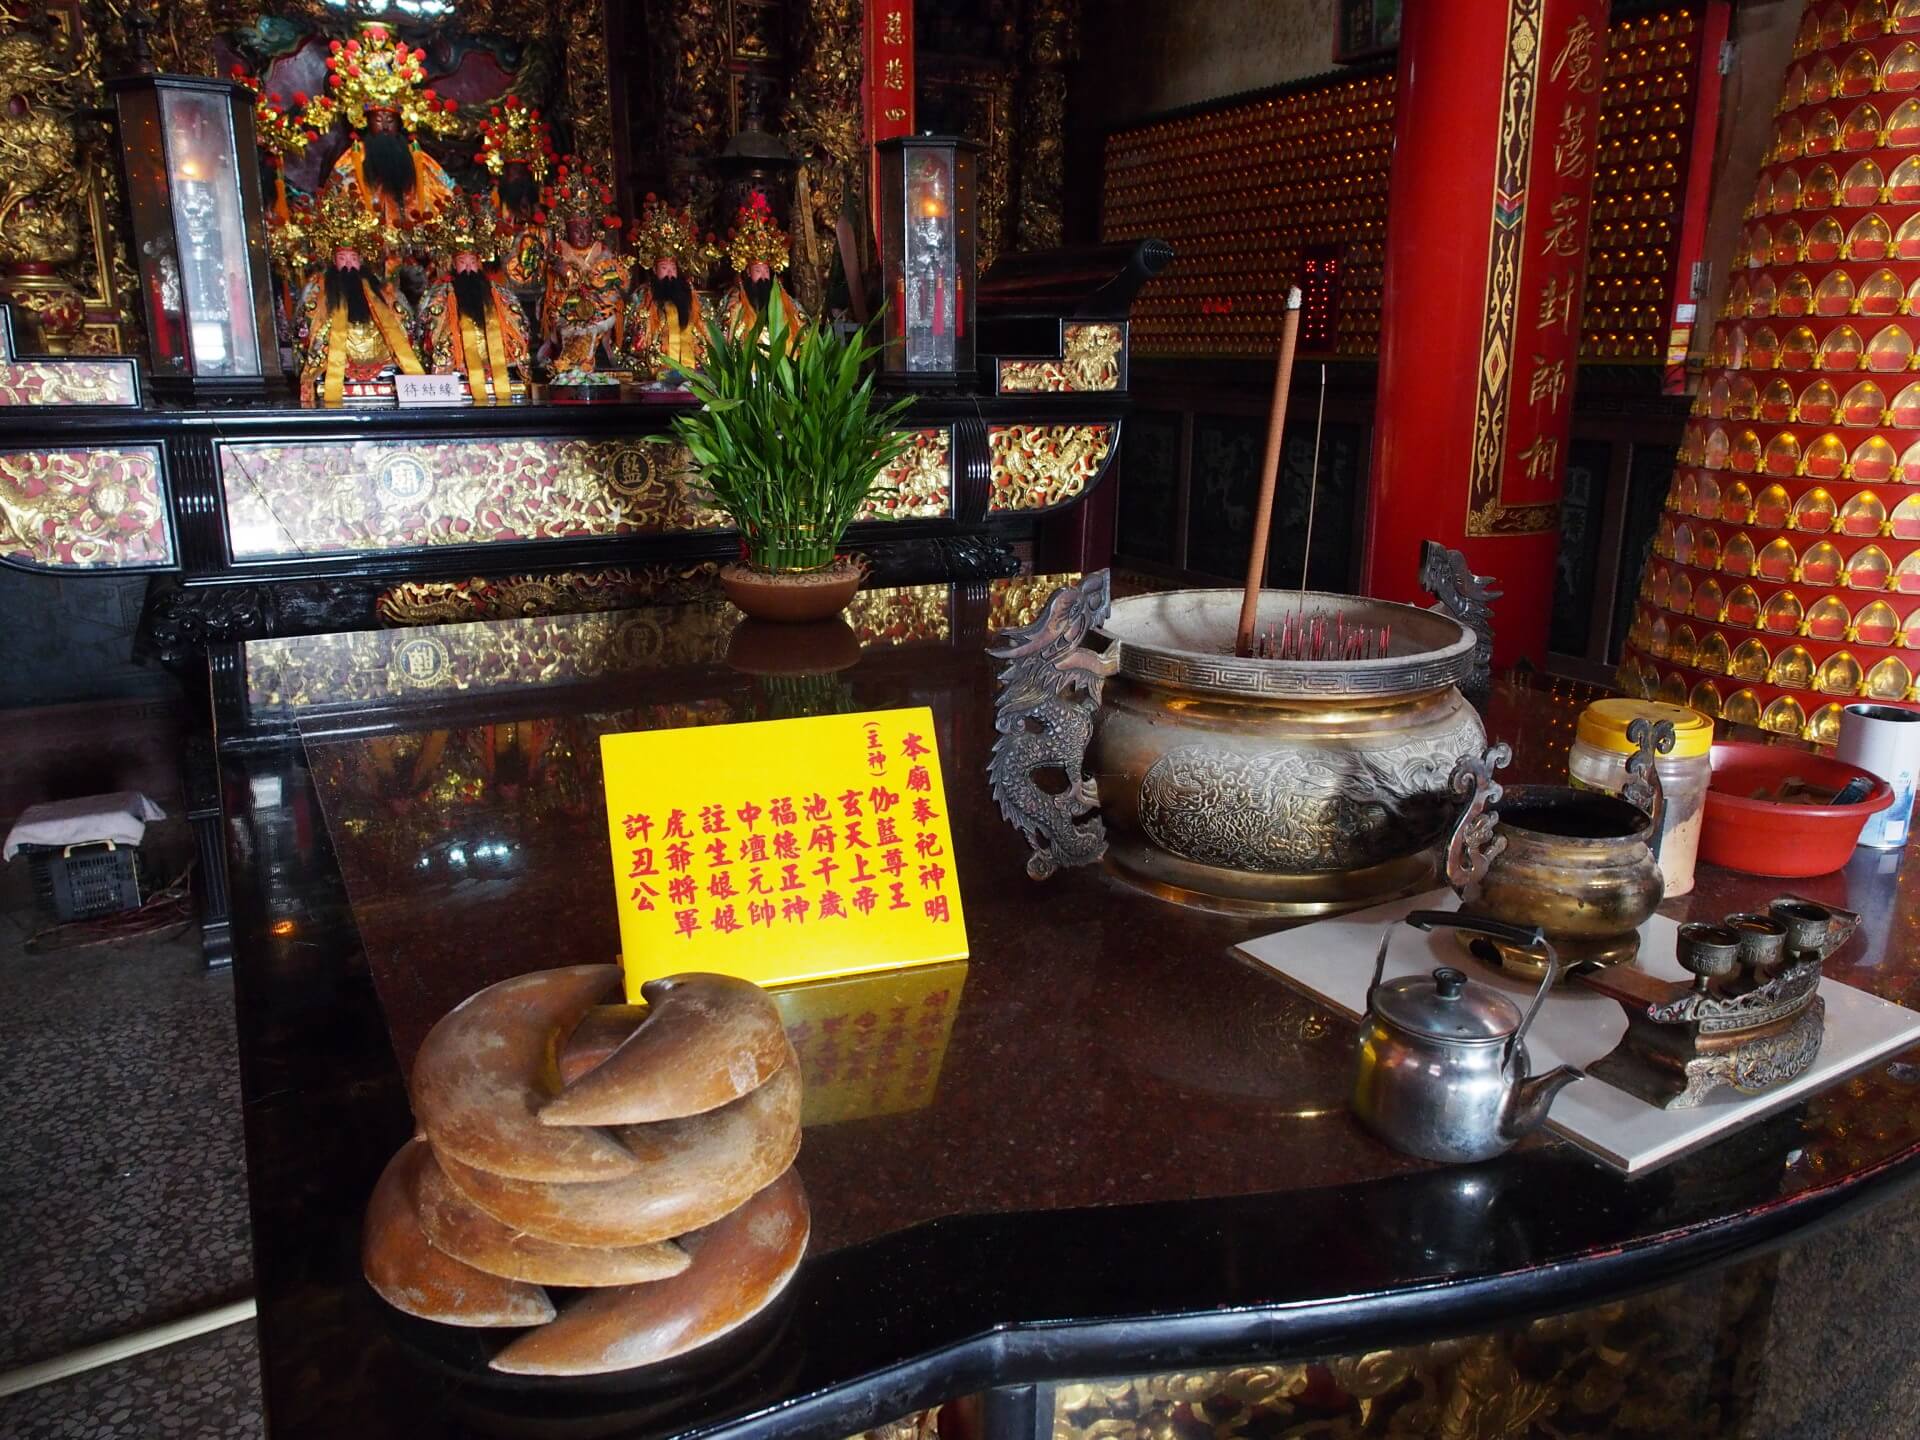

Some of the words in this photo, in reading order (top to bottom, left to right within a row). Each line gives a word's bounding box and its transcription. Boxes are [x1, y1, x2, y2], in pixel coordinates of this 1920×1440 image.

[622, 813, 660, 911] 許丑公
[662, 809, 702, 939] 虎爺將軍
[698, 804, 744, 934] 註生娘娘
[736, 801, 776, 928] 中壇元帥
[769, 796, 810, 924] 福德正神
[802, 792, 848, 920] 池府千歲
[837, 789, 879, 916] 玄天上帝
[868, 786, 911, 911] 伽藍尊王
[901, 732, 950, 924] 本廟奉祀神明
